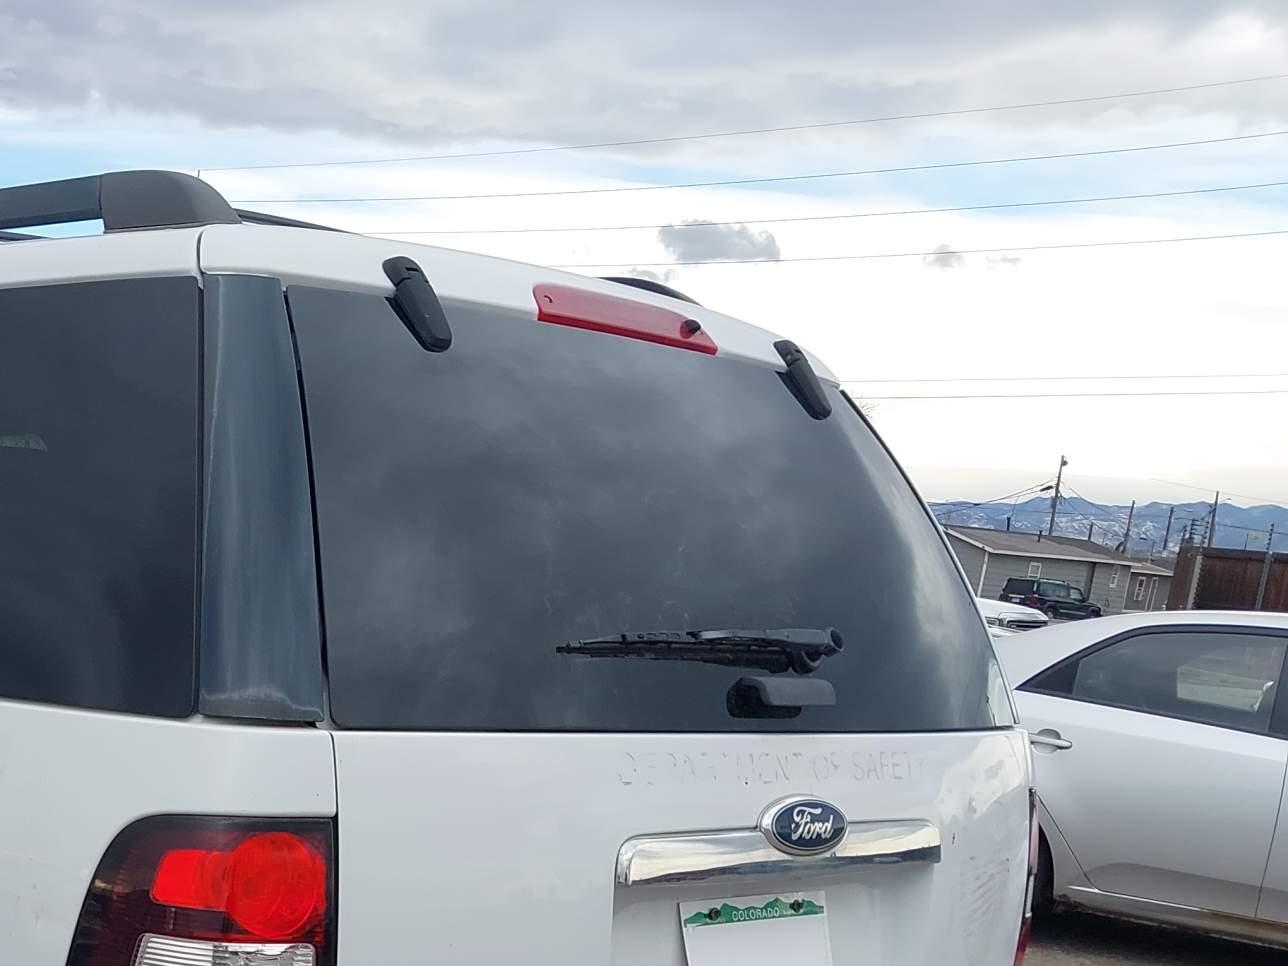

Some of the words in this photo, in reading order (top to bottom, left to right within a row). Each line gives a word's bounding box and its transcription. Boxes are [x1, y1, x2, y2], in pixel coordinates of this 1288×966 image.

[851, 751, 925, 782] SAFET
[791, 806, 834, 841] Ford
[732, 907, 780, 921] COLORADO
